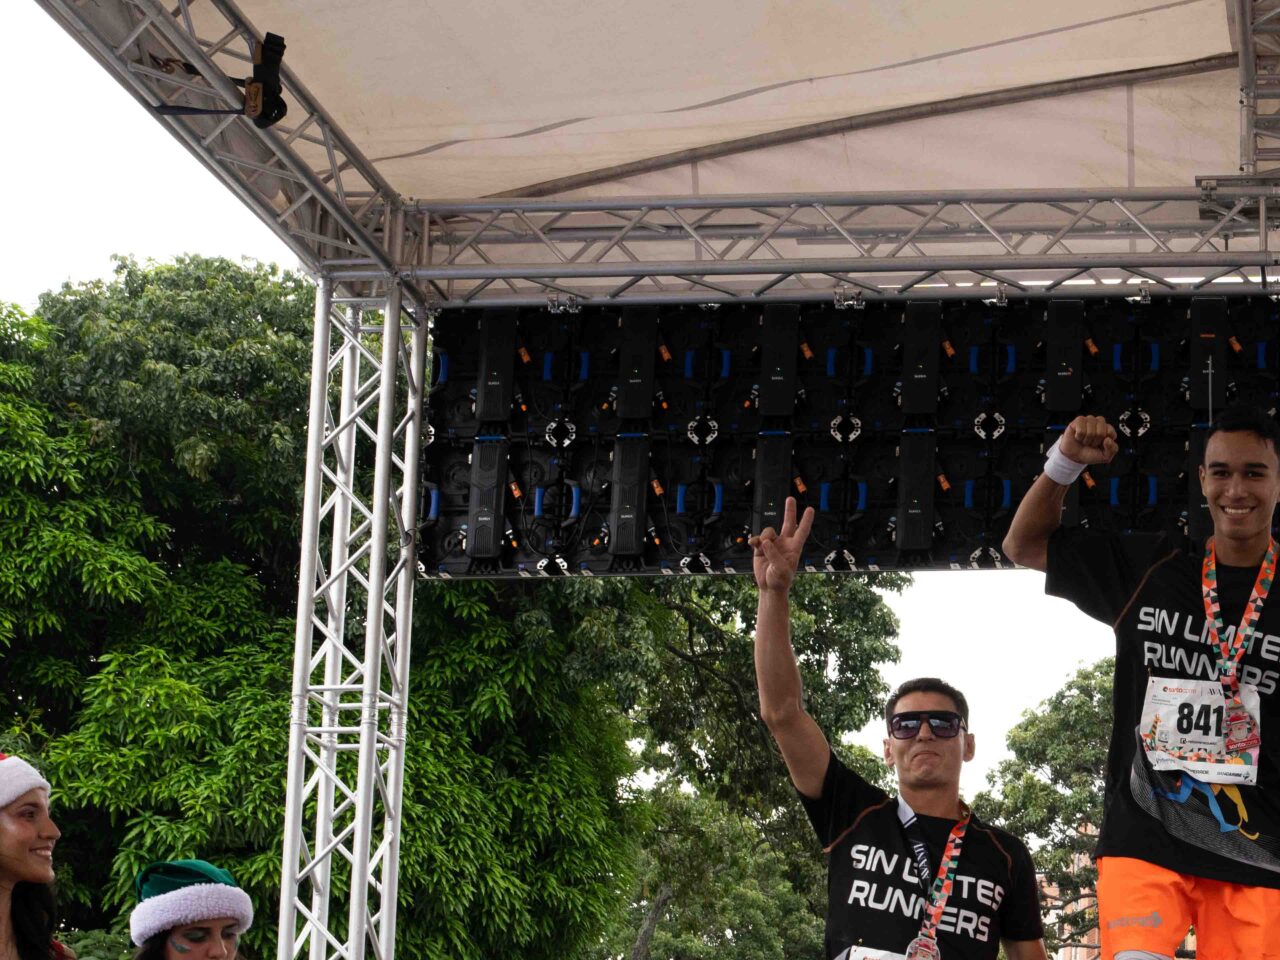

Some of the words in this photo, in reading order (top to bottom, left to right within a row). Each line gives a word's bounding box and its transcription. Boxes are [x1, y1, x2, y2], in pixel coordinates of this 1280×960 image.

[1137, 606, 1180, 637] SIN
[1144, 641, 1280, 695] RUNNRS
[1176, 702, 1224, 737] 841
[850, 844, 899, 875] SIN
[902, 857, 1005, 911] LTES
